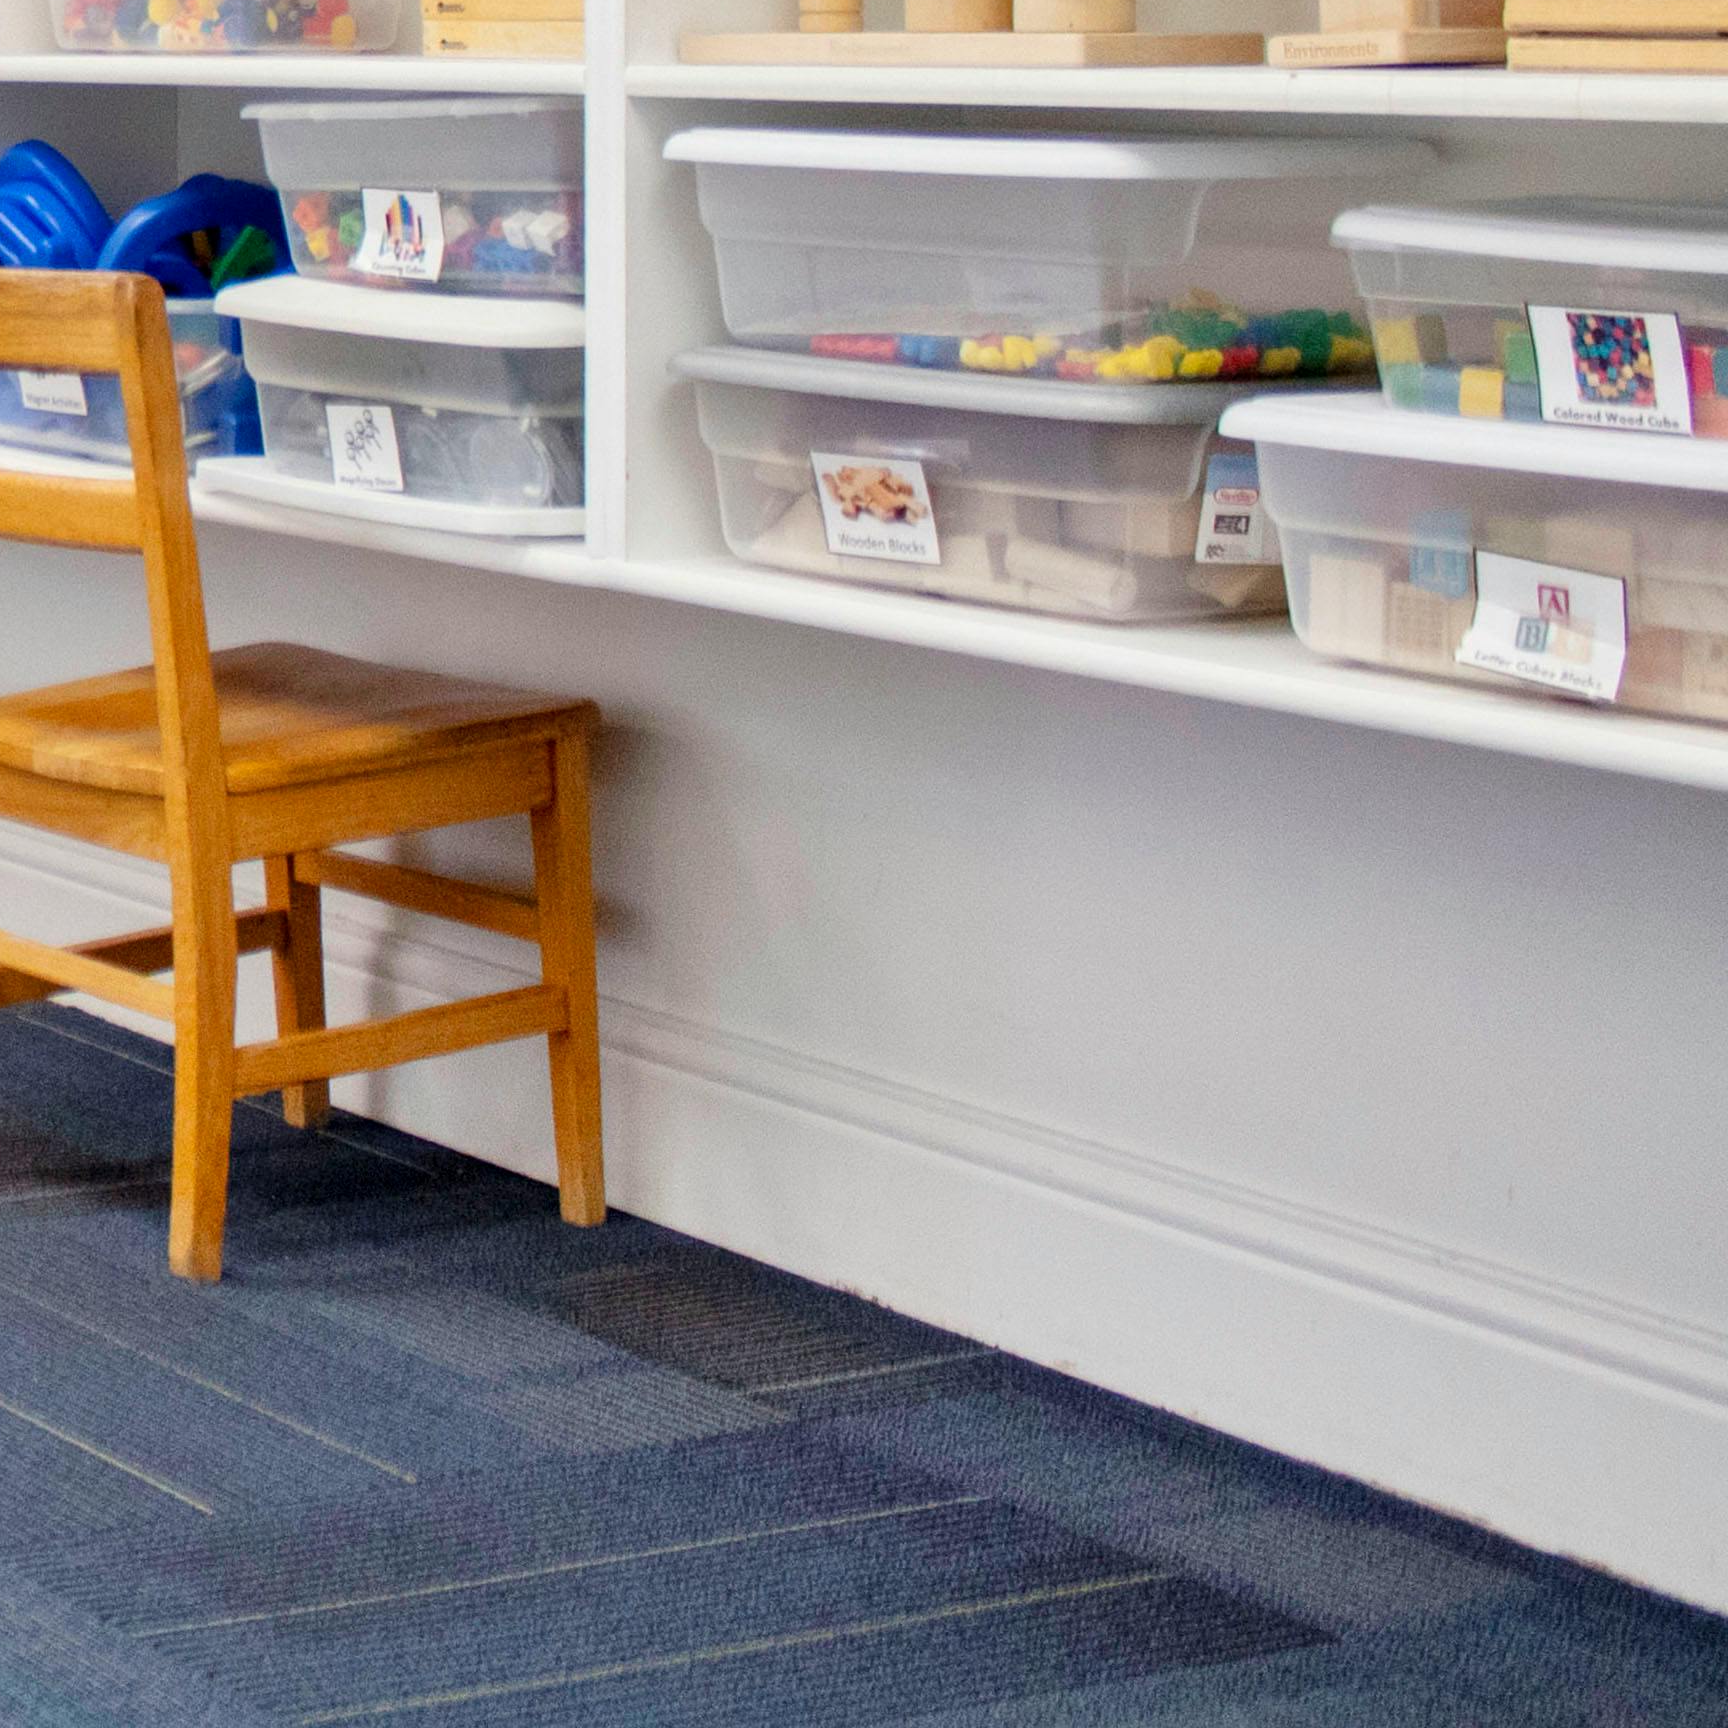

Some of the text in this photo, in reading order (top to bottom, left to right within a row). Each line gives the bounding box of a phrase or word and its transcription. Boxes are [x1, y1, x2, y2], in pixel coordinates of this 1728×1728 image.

[1282, 39, 1380, 60] Environments
[1553, 407, 1601, 423] Colored
[1604, 411, 1644, 426] Wood
[837, 532, 926, 555] Wooden Blocks
